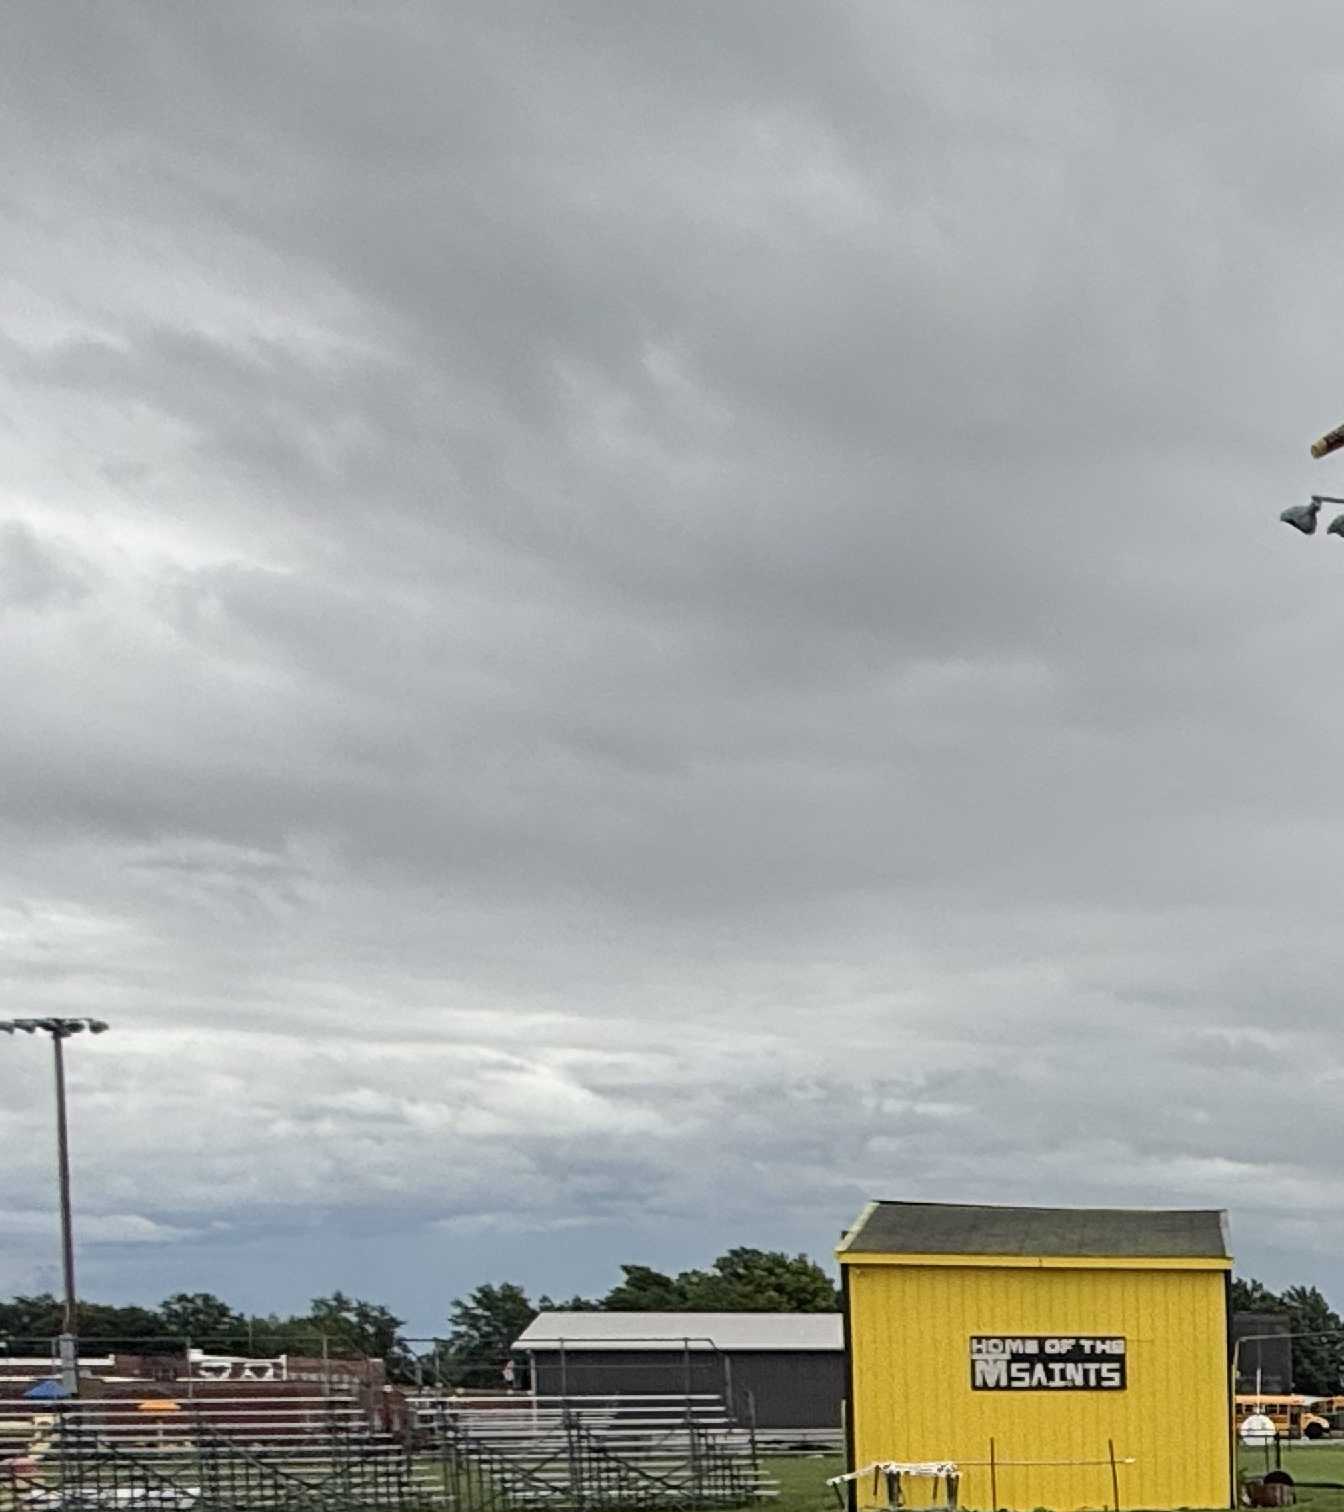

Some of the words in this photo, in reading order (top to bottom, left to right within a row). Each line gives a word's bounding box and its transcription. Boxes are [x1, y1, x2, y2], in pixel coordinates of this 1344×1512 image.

[972, 1338, 1039, 1354] HOME
[1044, 1338, 1076, 1354] OF
[1079, 1339, 1125, 1354] THE
